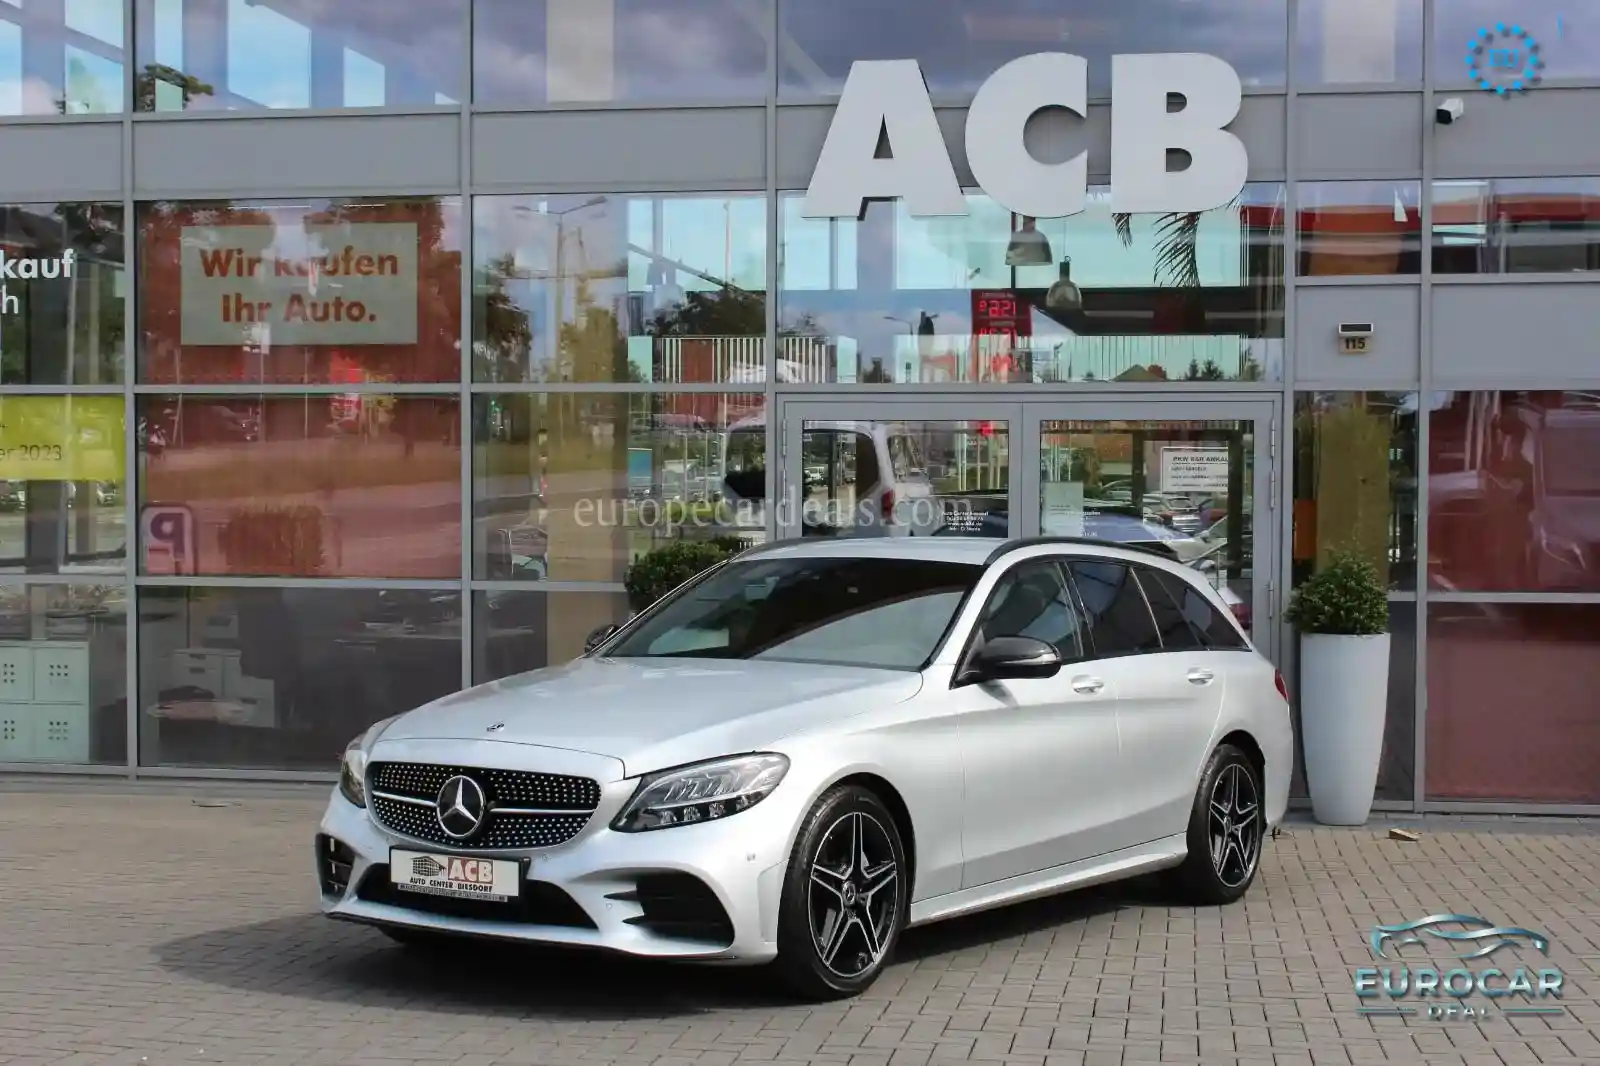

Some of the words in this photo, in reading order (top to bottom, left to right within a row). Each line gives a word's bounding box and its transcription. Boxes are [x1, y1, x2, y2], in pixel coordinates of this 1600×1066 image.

[801, 52, 1248, 219] ACB
[0, 249, 74, 279] kauf
[198, 248, 262, 277] Wir
[274, 245, 397, 277] kaufen
[221, 293, 272, 322] Ihr
[282, 293, 377, 322] Auto.
[1345, 337, 1366, 350] 115
[20, 444, 62, 461] 2023
[409, 876, 426, 886] AUTO
[429, 879, 453, 889] CENTER
[449, 858, 493, 883] ACB
